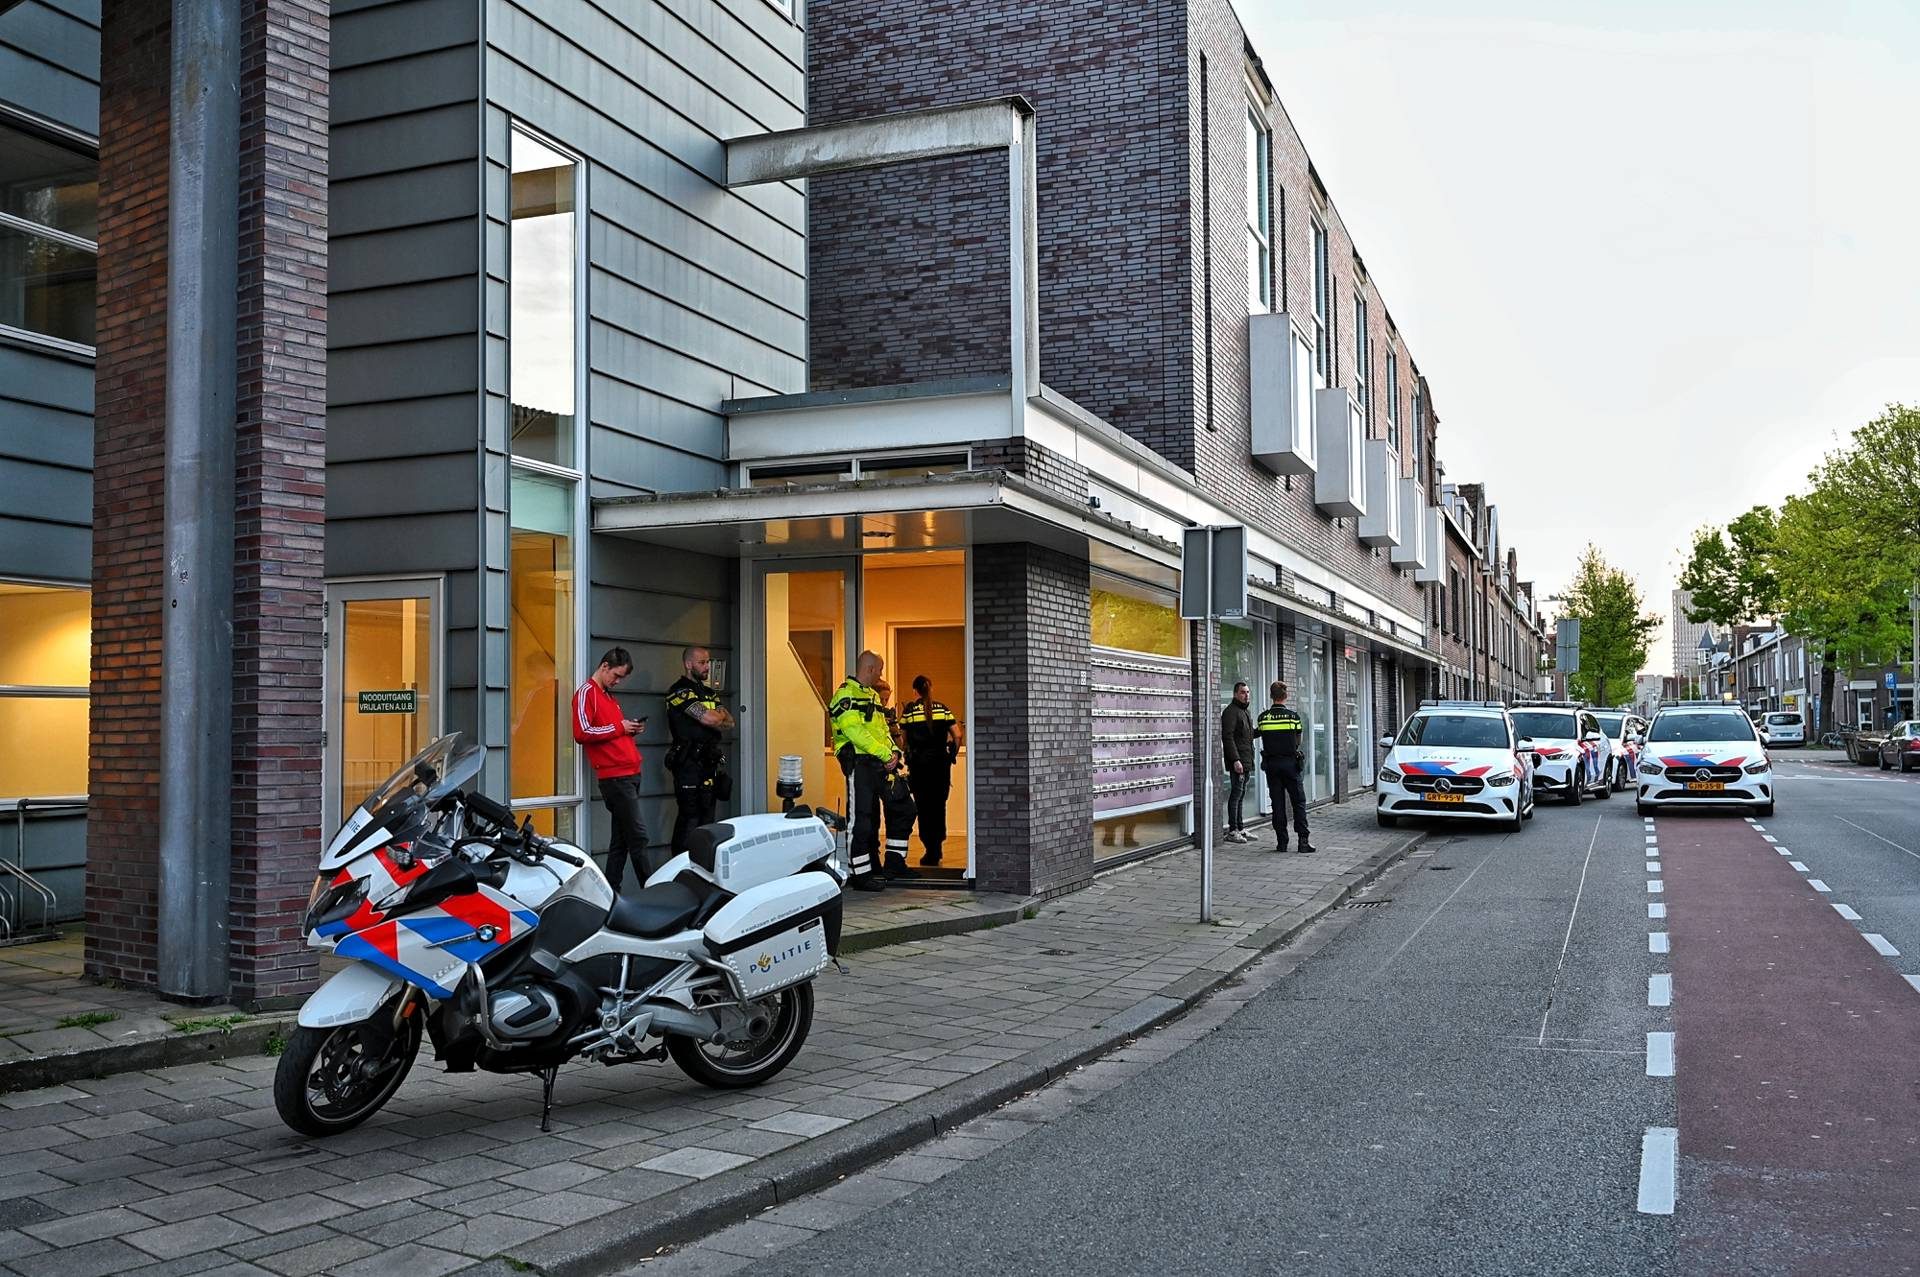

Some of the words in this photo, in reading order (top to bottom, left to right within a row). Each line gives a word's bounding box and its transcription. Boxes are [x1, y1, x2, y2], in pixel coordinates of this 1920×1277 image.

[362, 693, 411, 701] NOODUITGANG
[359, 703, 394, 711] VRIJLATEN
[395, 702, 414, 710] A.U.B.
[749, 940, 811, 974] POLITIE
